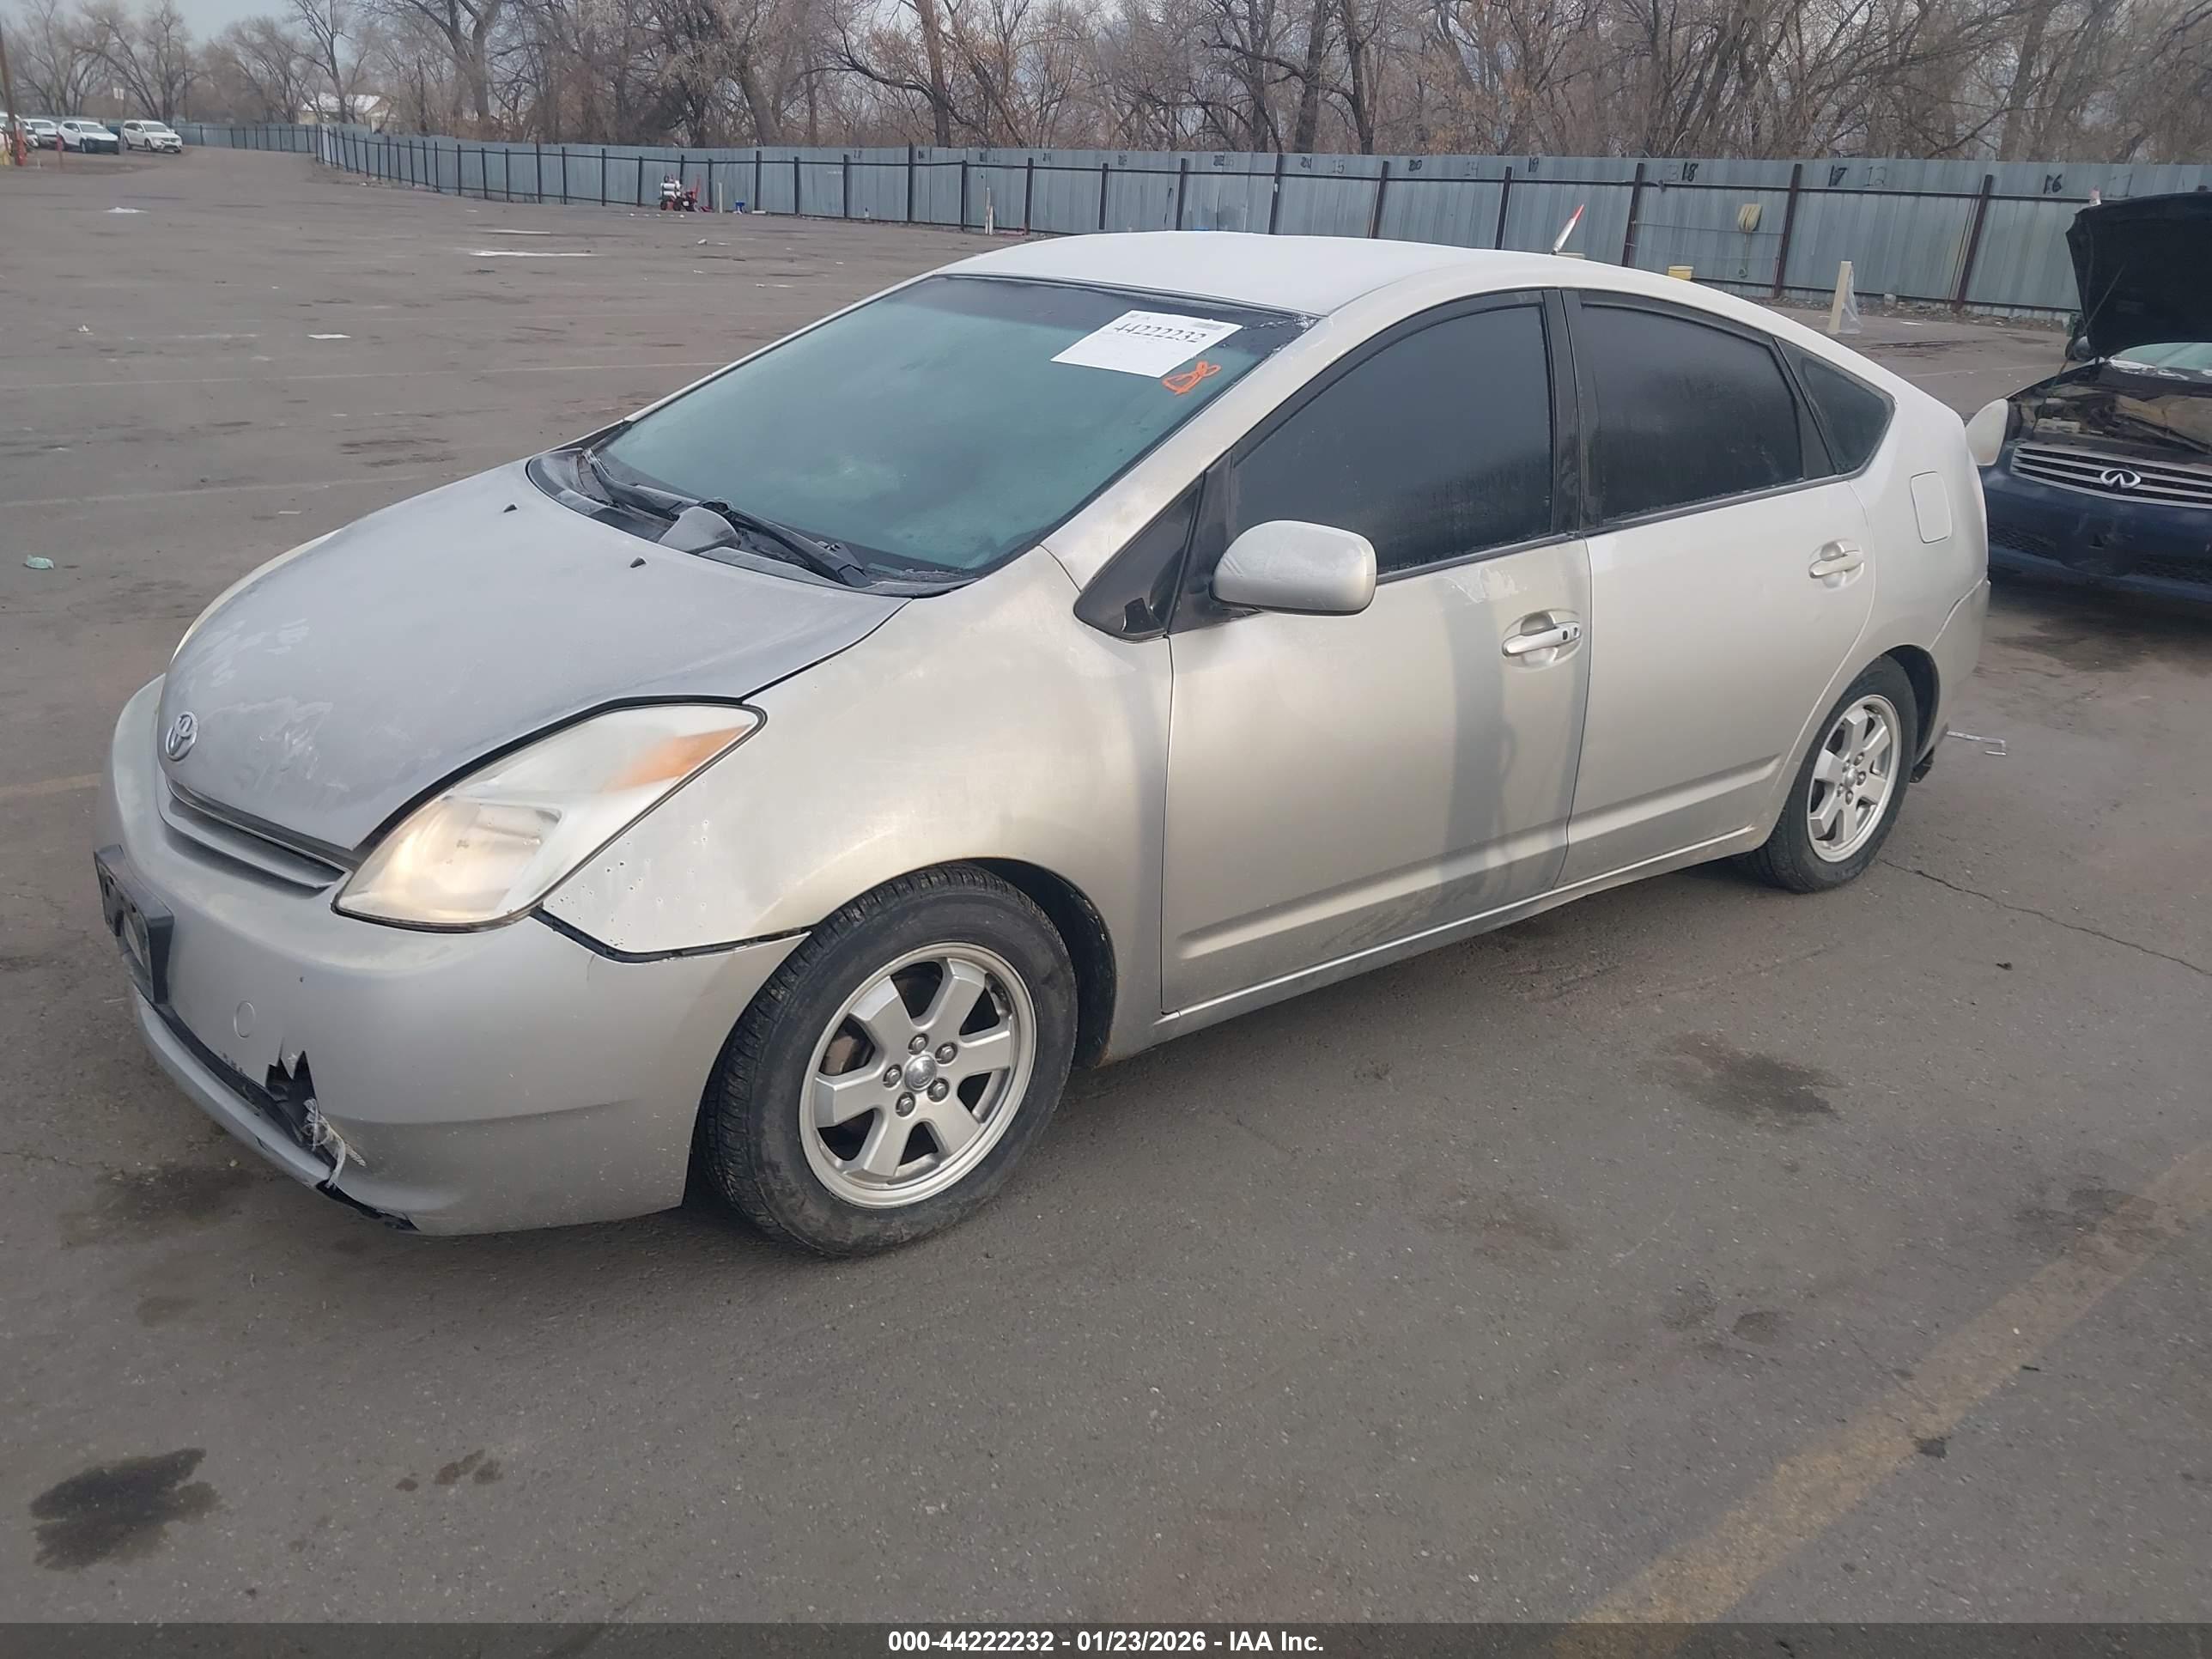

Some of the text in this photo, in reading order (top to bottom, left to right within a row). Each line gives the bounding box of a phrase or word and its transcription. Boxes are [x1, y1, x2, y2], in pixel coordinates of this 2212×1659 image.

[1332, 159, 1345, 173] 15
[1682, 161, 1698, 182] 18
[1828, 165, 1847, 186] 17
[1863, 167, 1887, 186] 12
[2043, 173, 2062, 194] 16
[1114, 322, 1207, 343] 44222232
